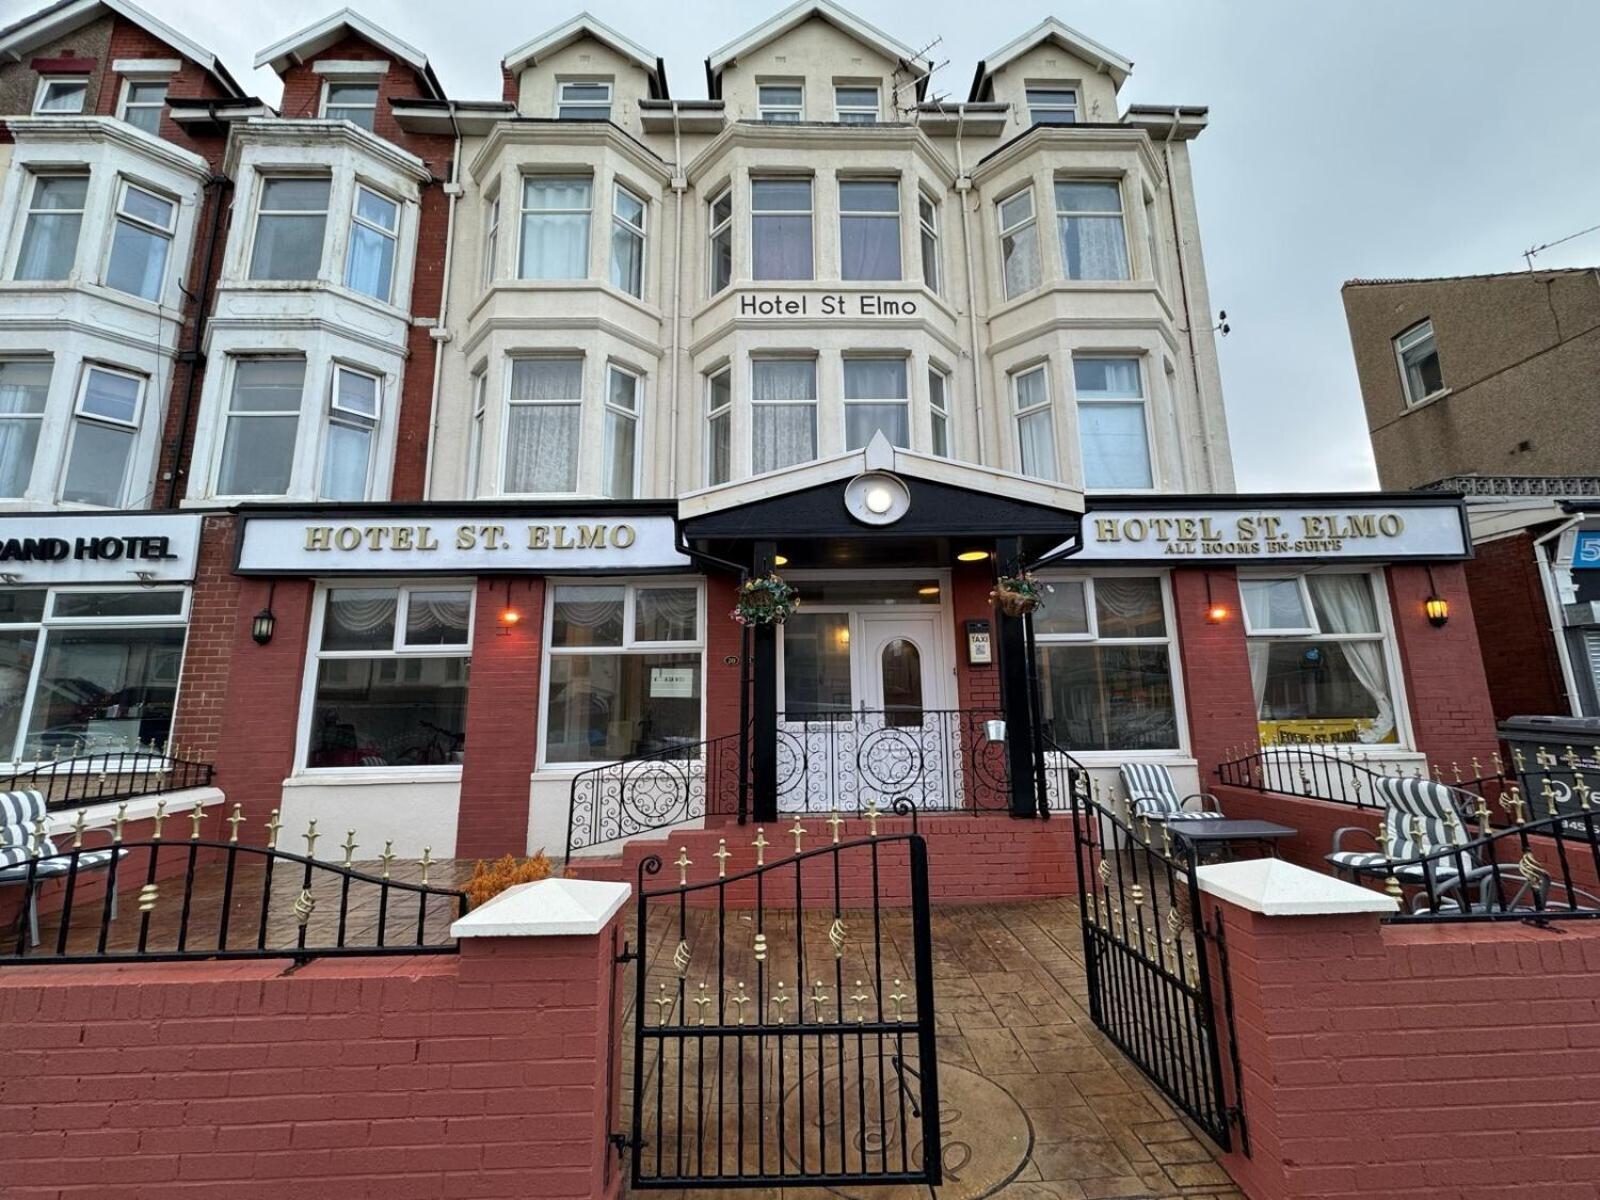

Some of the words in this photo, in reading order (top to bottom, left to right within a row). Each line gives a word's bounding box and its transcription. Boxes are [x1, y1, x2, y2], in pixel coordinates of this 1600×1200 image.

[740, 295, 806, 315] Hotel
[821, 295, 845, 315] St
[860, 295, 917, 315] Elmo
[303, 525, 438, 550] HOTEL
[456, 524, 510, 549] ST.
[526, 523, 636, 549] ELMO
[1094, 517, 1221, 542] HOTEL
[1236, 516, 1289, 541] ST.
[1301, 513, 1405, 539] ELMO
[0, 537, 70, 561] AND
[74, 536, 178, 561] HOTEL
[1164, 542, 1196, 554] ALL
[1202, 542, 1260, 554] ROOMS
[1267, 540, 1343, 553] EN-SUITE
